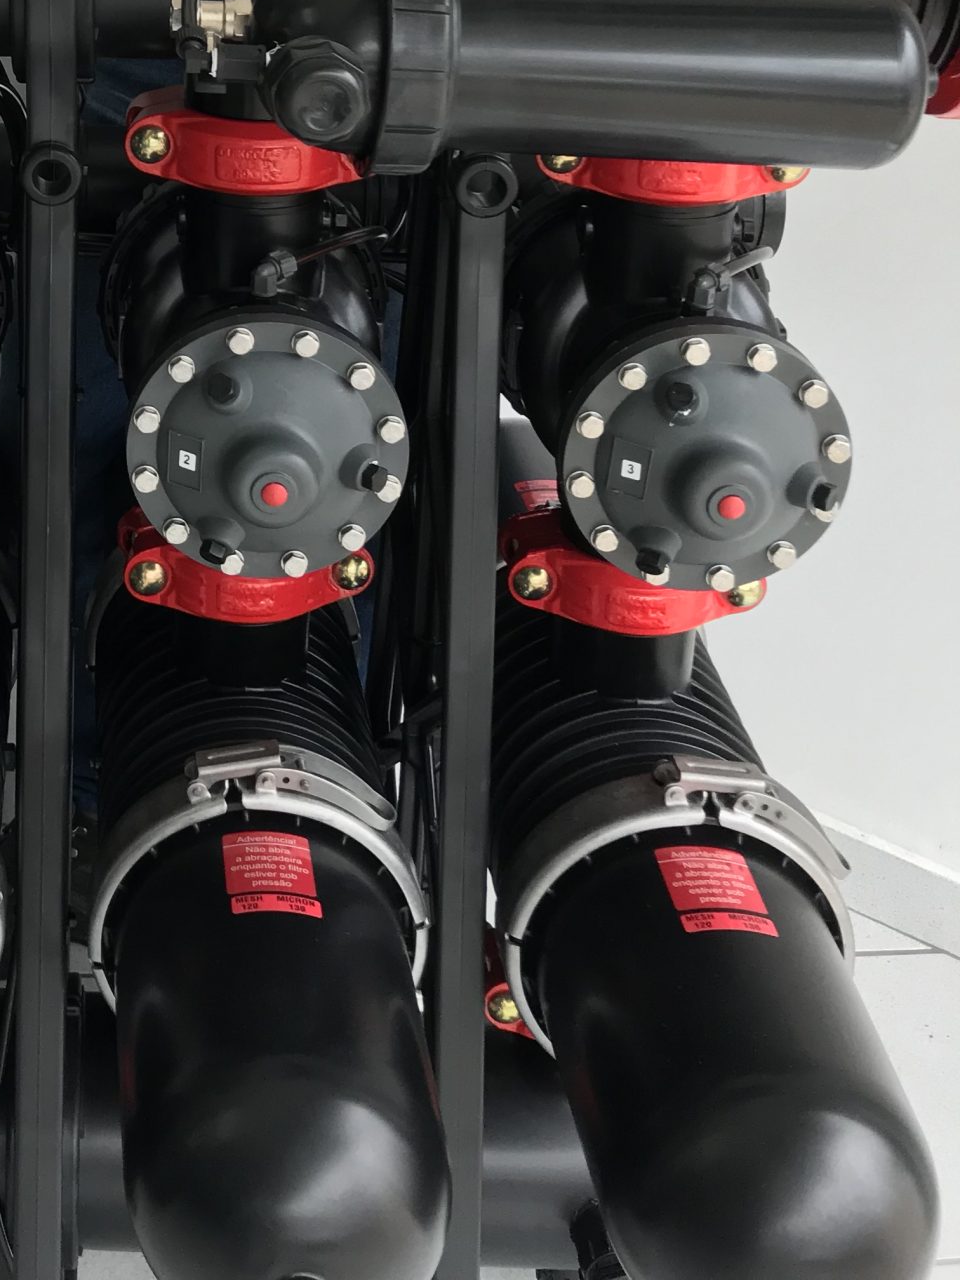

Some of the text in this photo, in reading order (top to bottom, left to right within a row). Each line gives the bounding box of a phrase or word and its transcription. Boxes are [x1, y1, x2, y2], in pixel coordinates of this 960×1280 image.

[183, 454, 191, 466] 2
[627, 464, 635, 475] 3
[236, 835, 297, 845] Advertência!
[268, 846, 292, 855] abra
[244, 854, 303, 865] abraçadeira
[230, 863, 277, 873] enquanto
[287, 864, 310, 875] filtro
[244, 871, 298, 880] estiver sob
[251, 878, 293, 888] pressão
[235, 895, 316, 908] MESH MICRON
